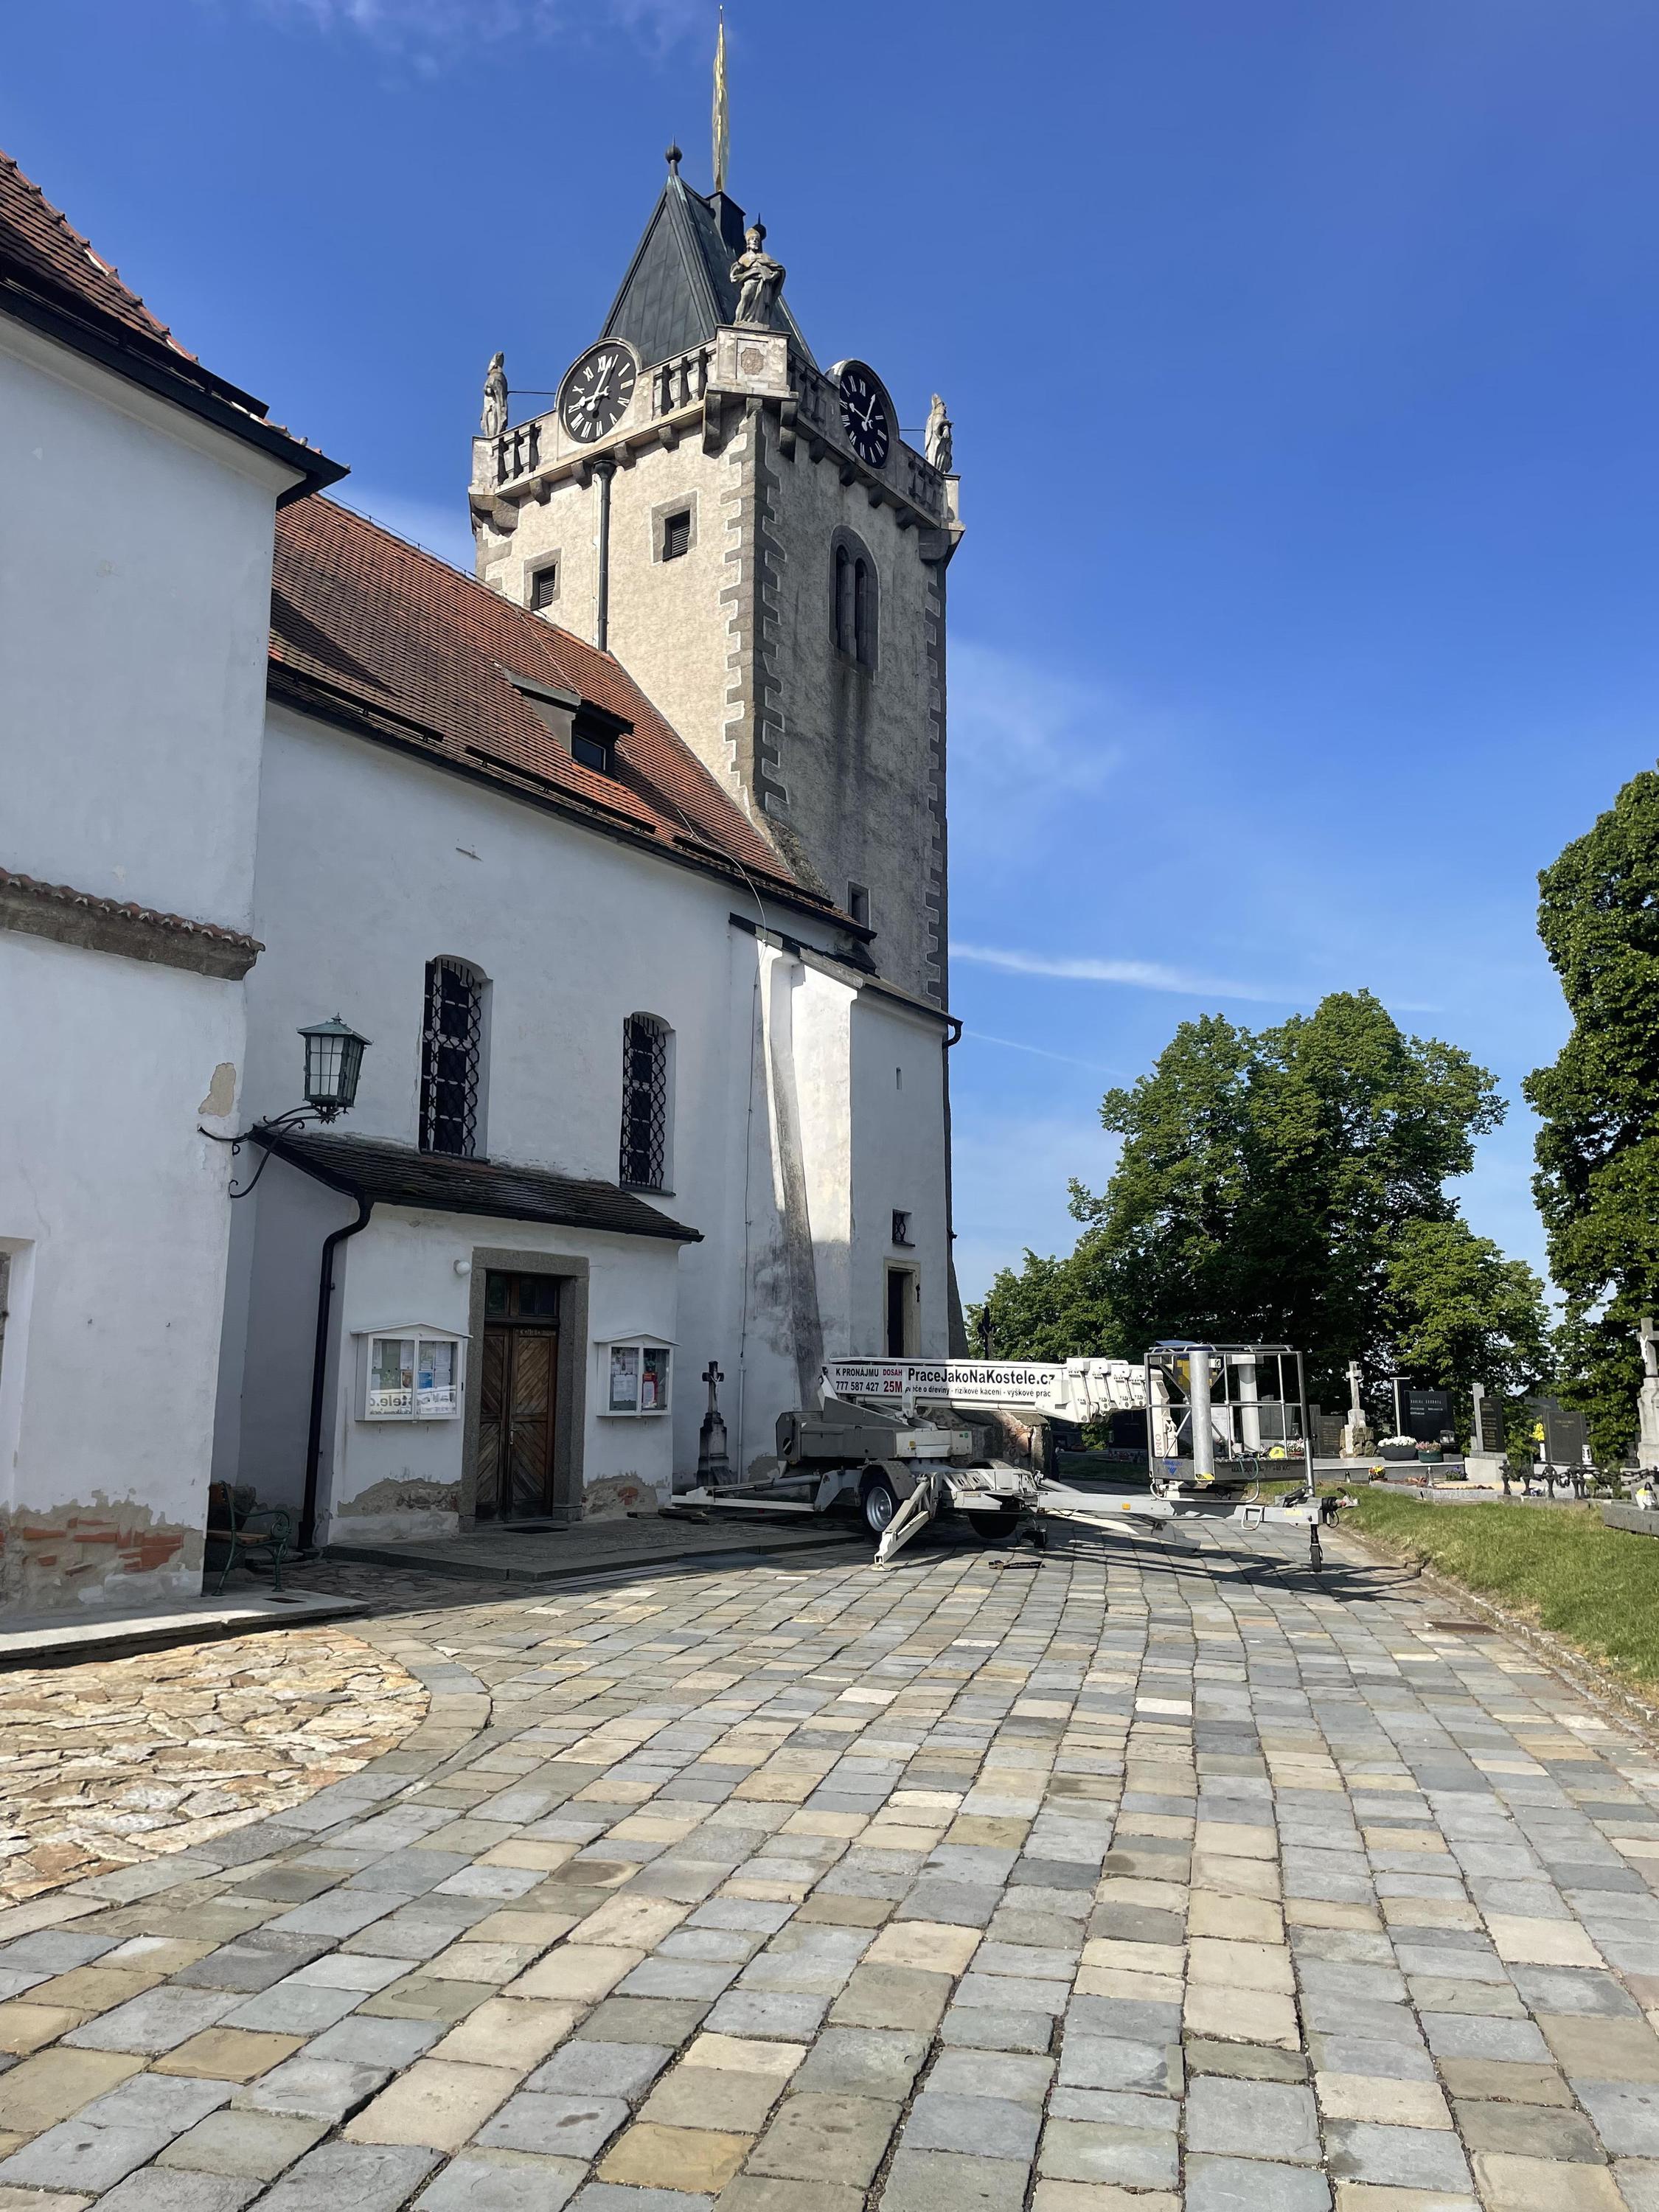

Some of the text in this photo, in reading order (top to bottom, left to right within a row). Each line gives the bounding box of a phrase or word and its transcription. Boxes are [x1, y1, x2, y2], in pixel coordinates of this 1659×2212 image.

[582, 366, 594, 382] XI
[571, 385, 585, 394] X
[841, 380, 851, 397] X
[609, 412, 618, 425] V
[835, 1366, 879, 1377] K PRONÁJMU
[908, 1367, 1055, 1385] PraceJakoNaKostele.cz
[835, 1380, 880, 1392] 777 587 427
[883, 1380, 902, 1393] 25M
[1007, 1388, 1034, 1398] výškové
[1036, 1388, 1051, 1399] prác
